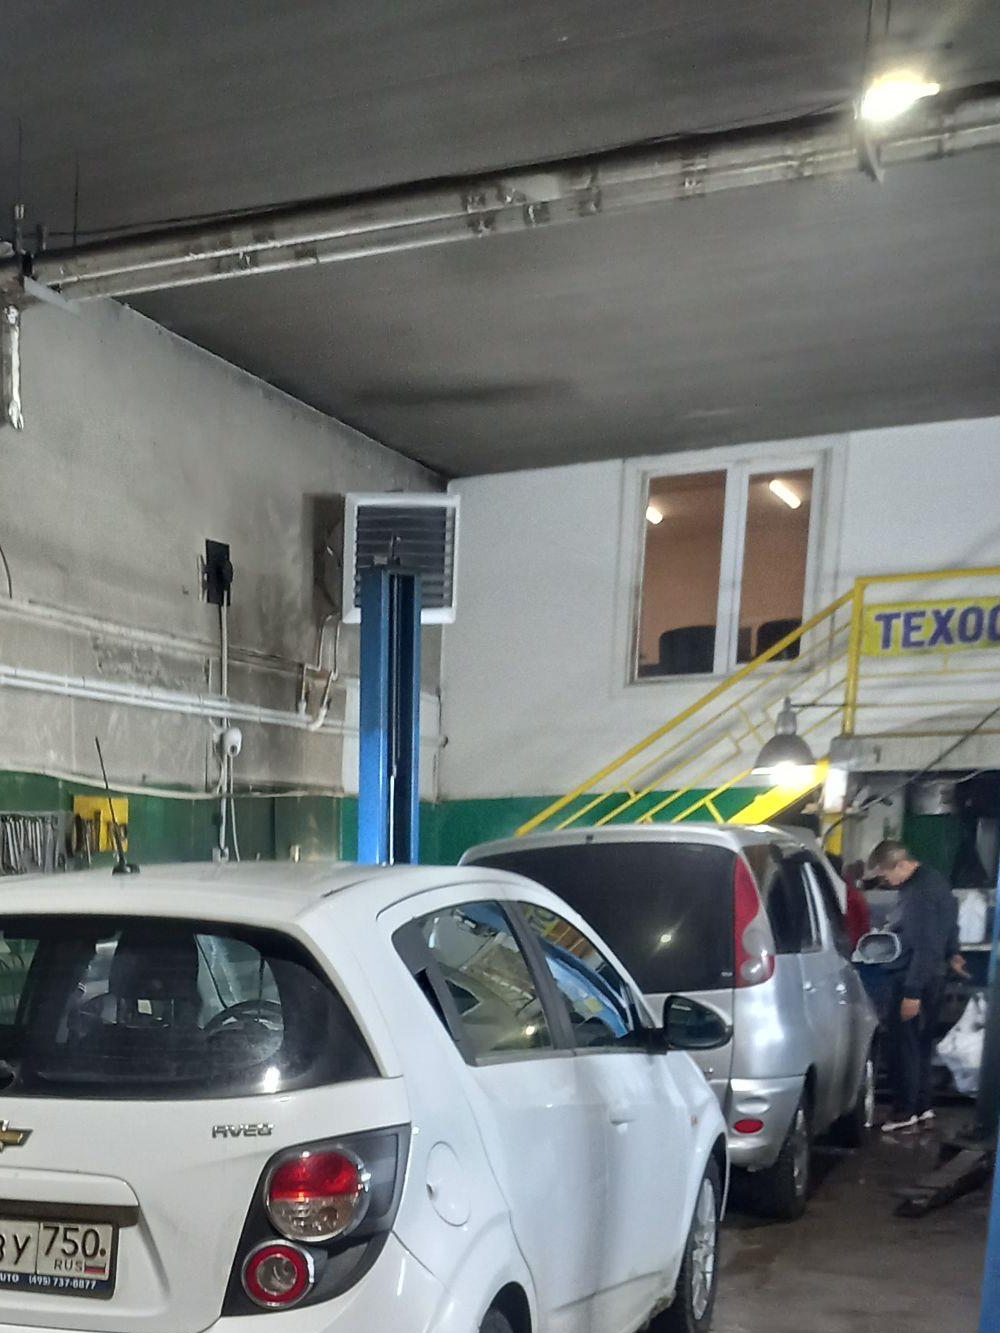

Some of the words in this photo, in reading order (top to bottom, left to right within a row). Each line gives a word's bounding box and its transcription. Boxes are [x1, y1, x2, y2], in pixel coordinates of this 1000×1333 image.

[212, 1122, 274, 1139] AVEO
[42, 1225, 100, 1259] 750
[53, 1259, 83, 1273] RUS
